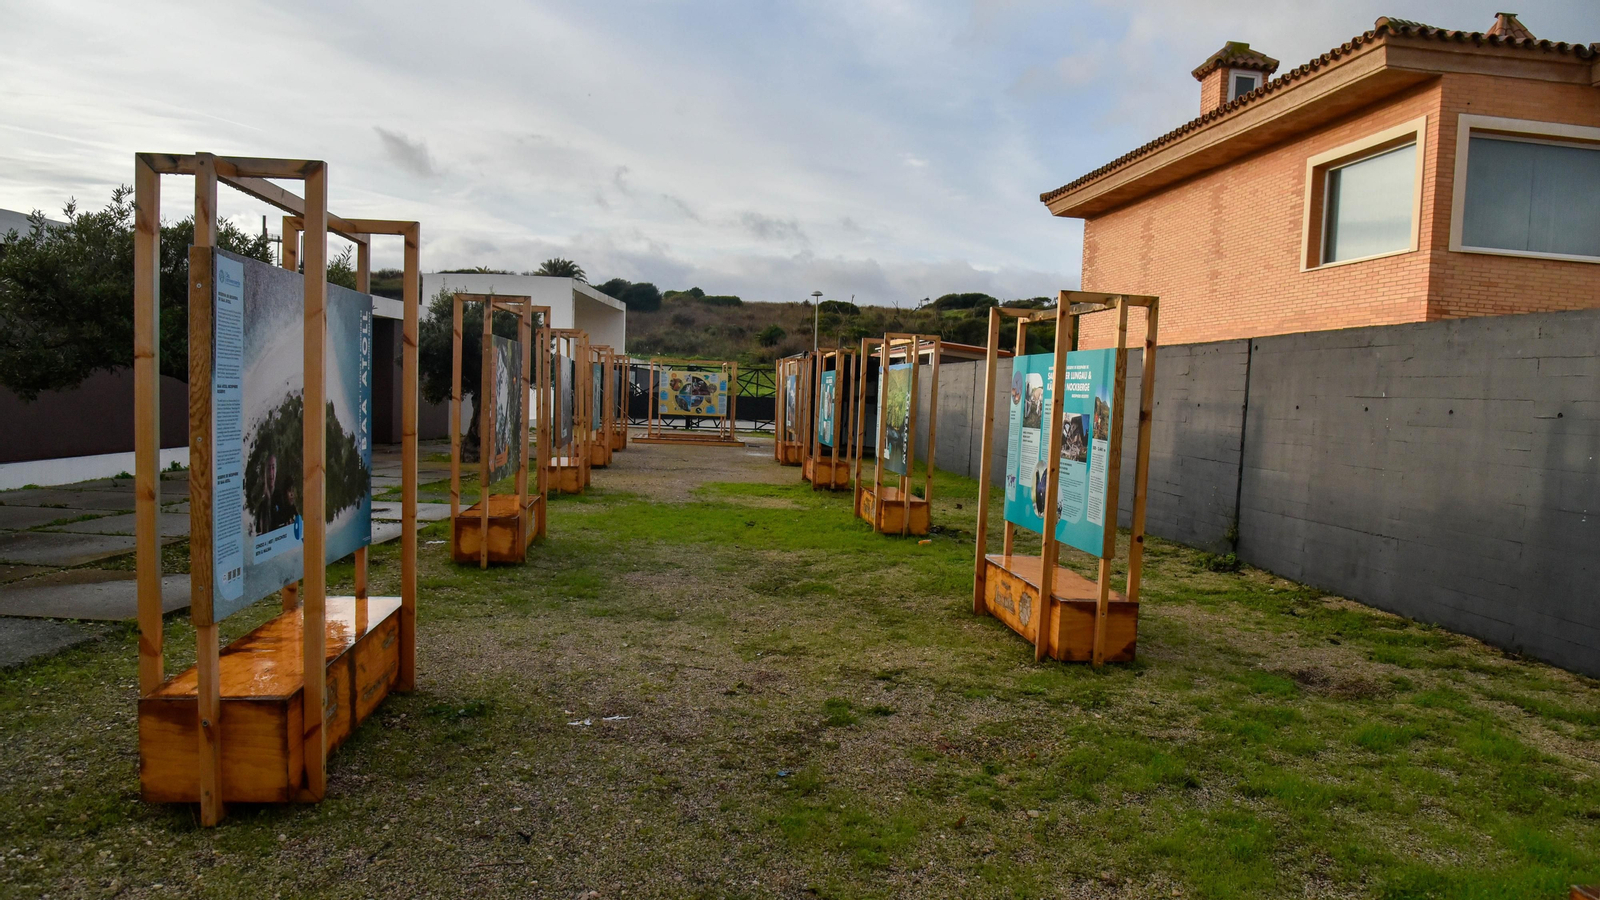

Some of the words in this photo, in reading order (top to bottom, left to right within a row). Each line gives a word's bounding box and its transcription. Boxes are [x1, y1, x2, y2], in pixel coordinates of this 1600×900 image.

[1071, 371, 1088, 380] LUNGAU
[1088, 371, 1092, 380] &
[1066, 383, 1090, 392] NOCKBERGE
